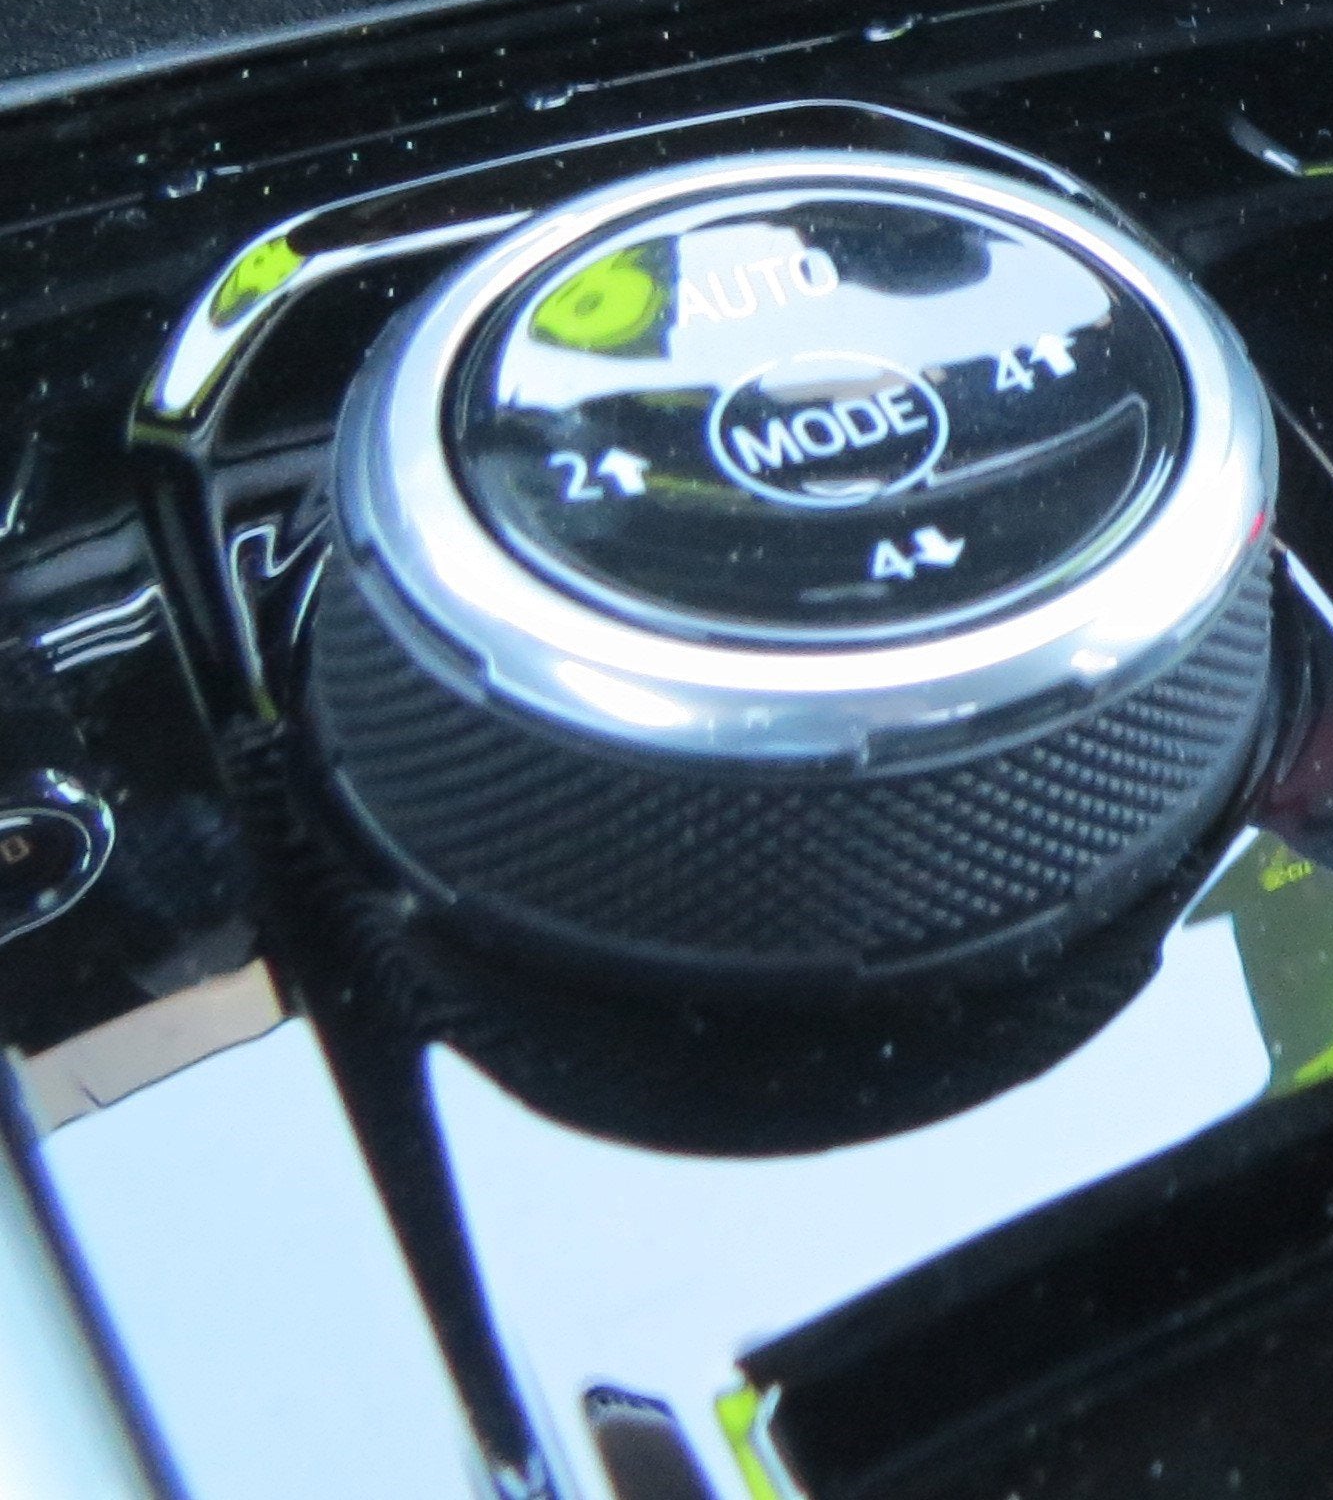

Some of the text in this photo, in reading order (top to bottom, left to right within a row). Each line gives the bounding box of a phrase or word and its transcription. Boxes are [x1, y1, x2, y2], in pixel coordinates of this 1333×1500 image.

[677, 247, 841, 330] AUTO
[995, 347, 1035, 393] 4
[729, 384, 930, 474] MODE
[547, 450, 604, 501] 2
[871, 539, 916, 581] 4
